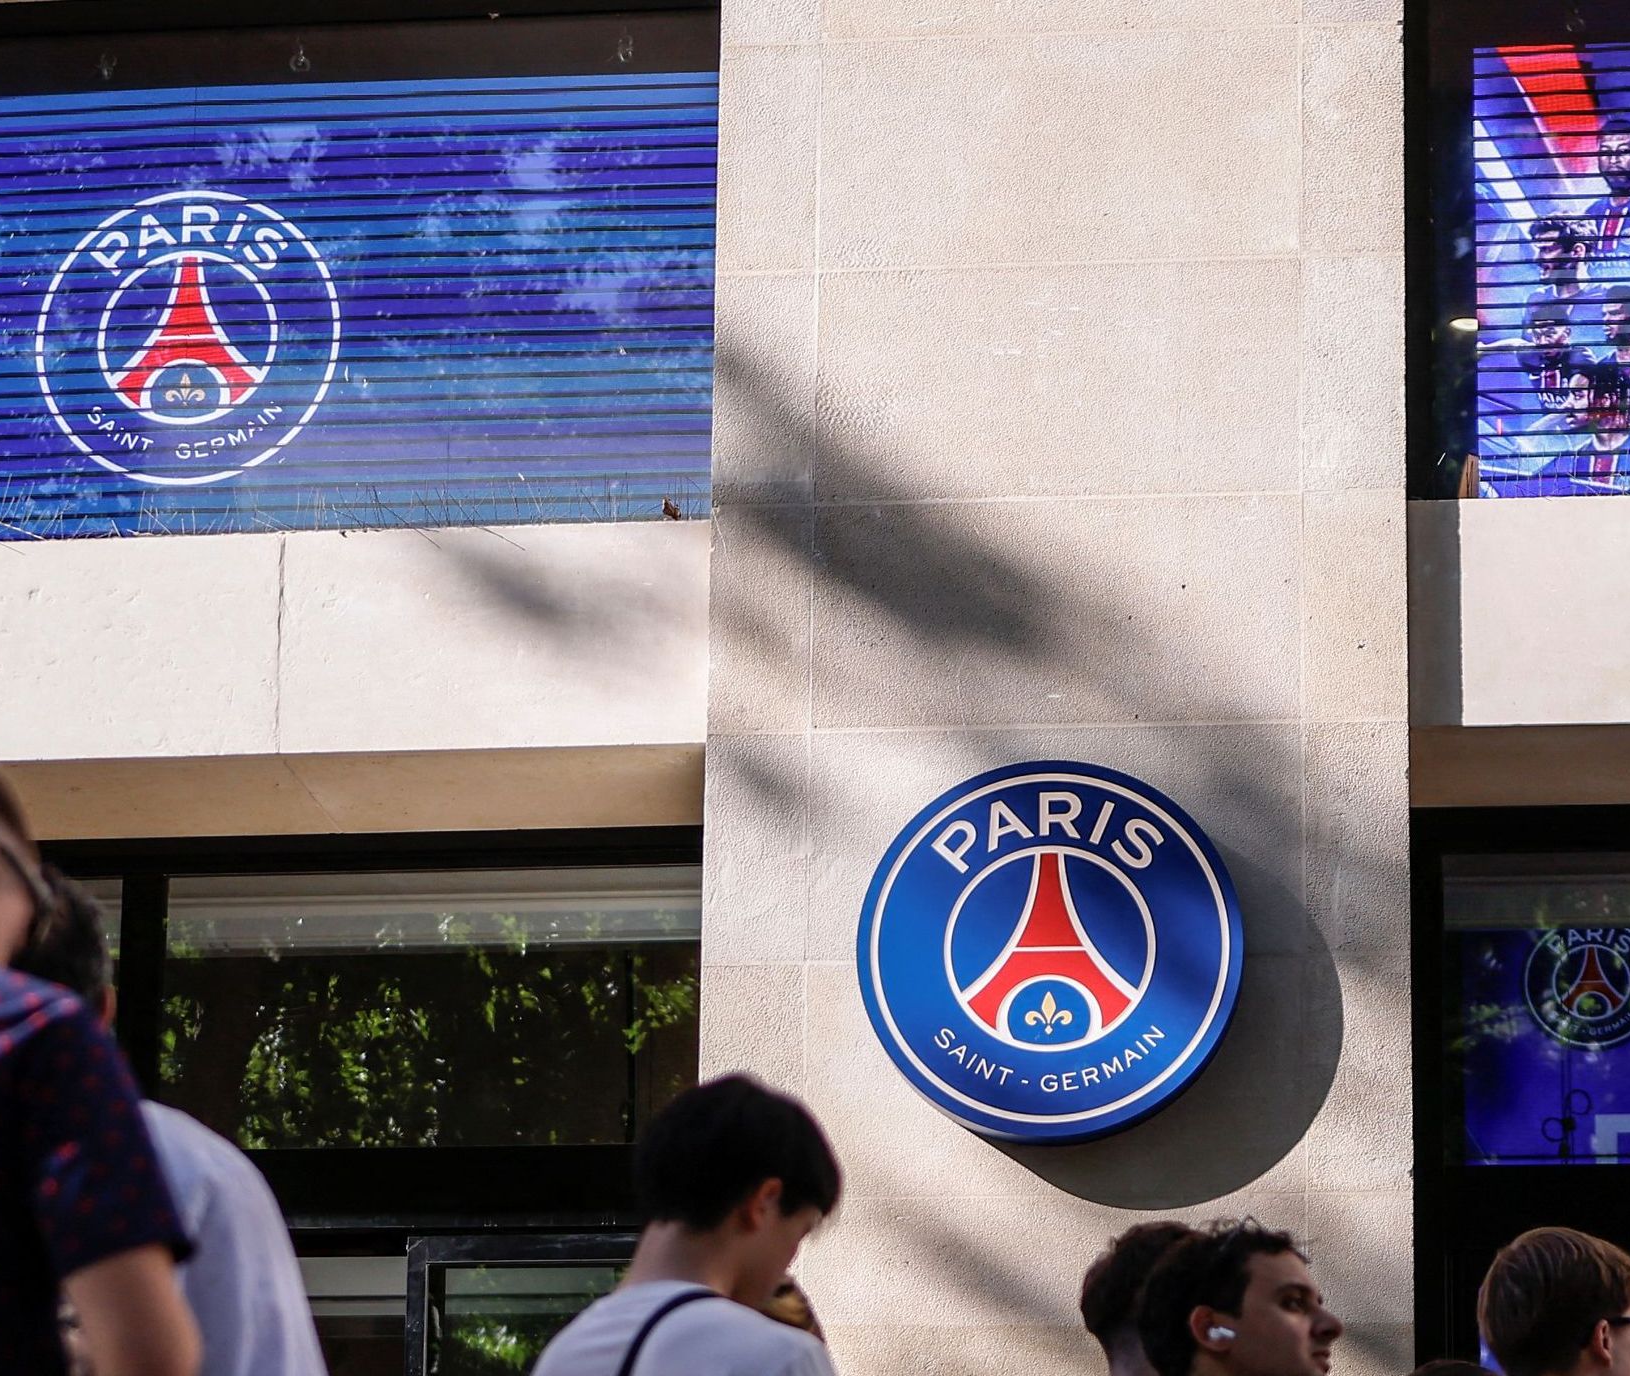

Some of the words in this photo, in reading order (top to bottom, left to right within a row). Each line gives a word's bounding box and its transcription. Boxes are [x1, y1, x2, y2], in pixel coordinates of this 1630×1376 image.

[89, 204, 289, 277] PARIS
[87, 406, 154, 451] SAINT
[175, 401, 283, 459] GERMAIN
[931, 791, 1164, 875] PARIS
[934, 1028, 1013, 1086] SAINT
[1039, 1024, 1165, 1092] GERMAIN
